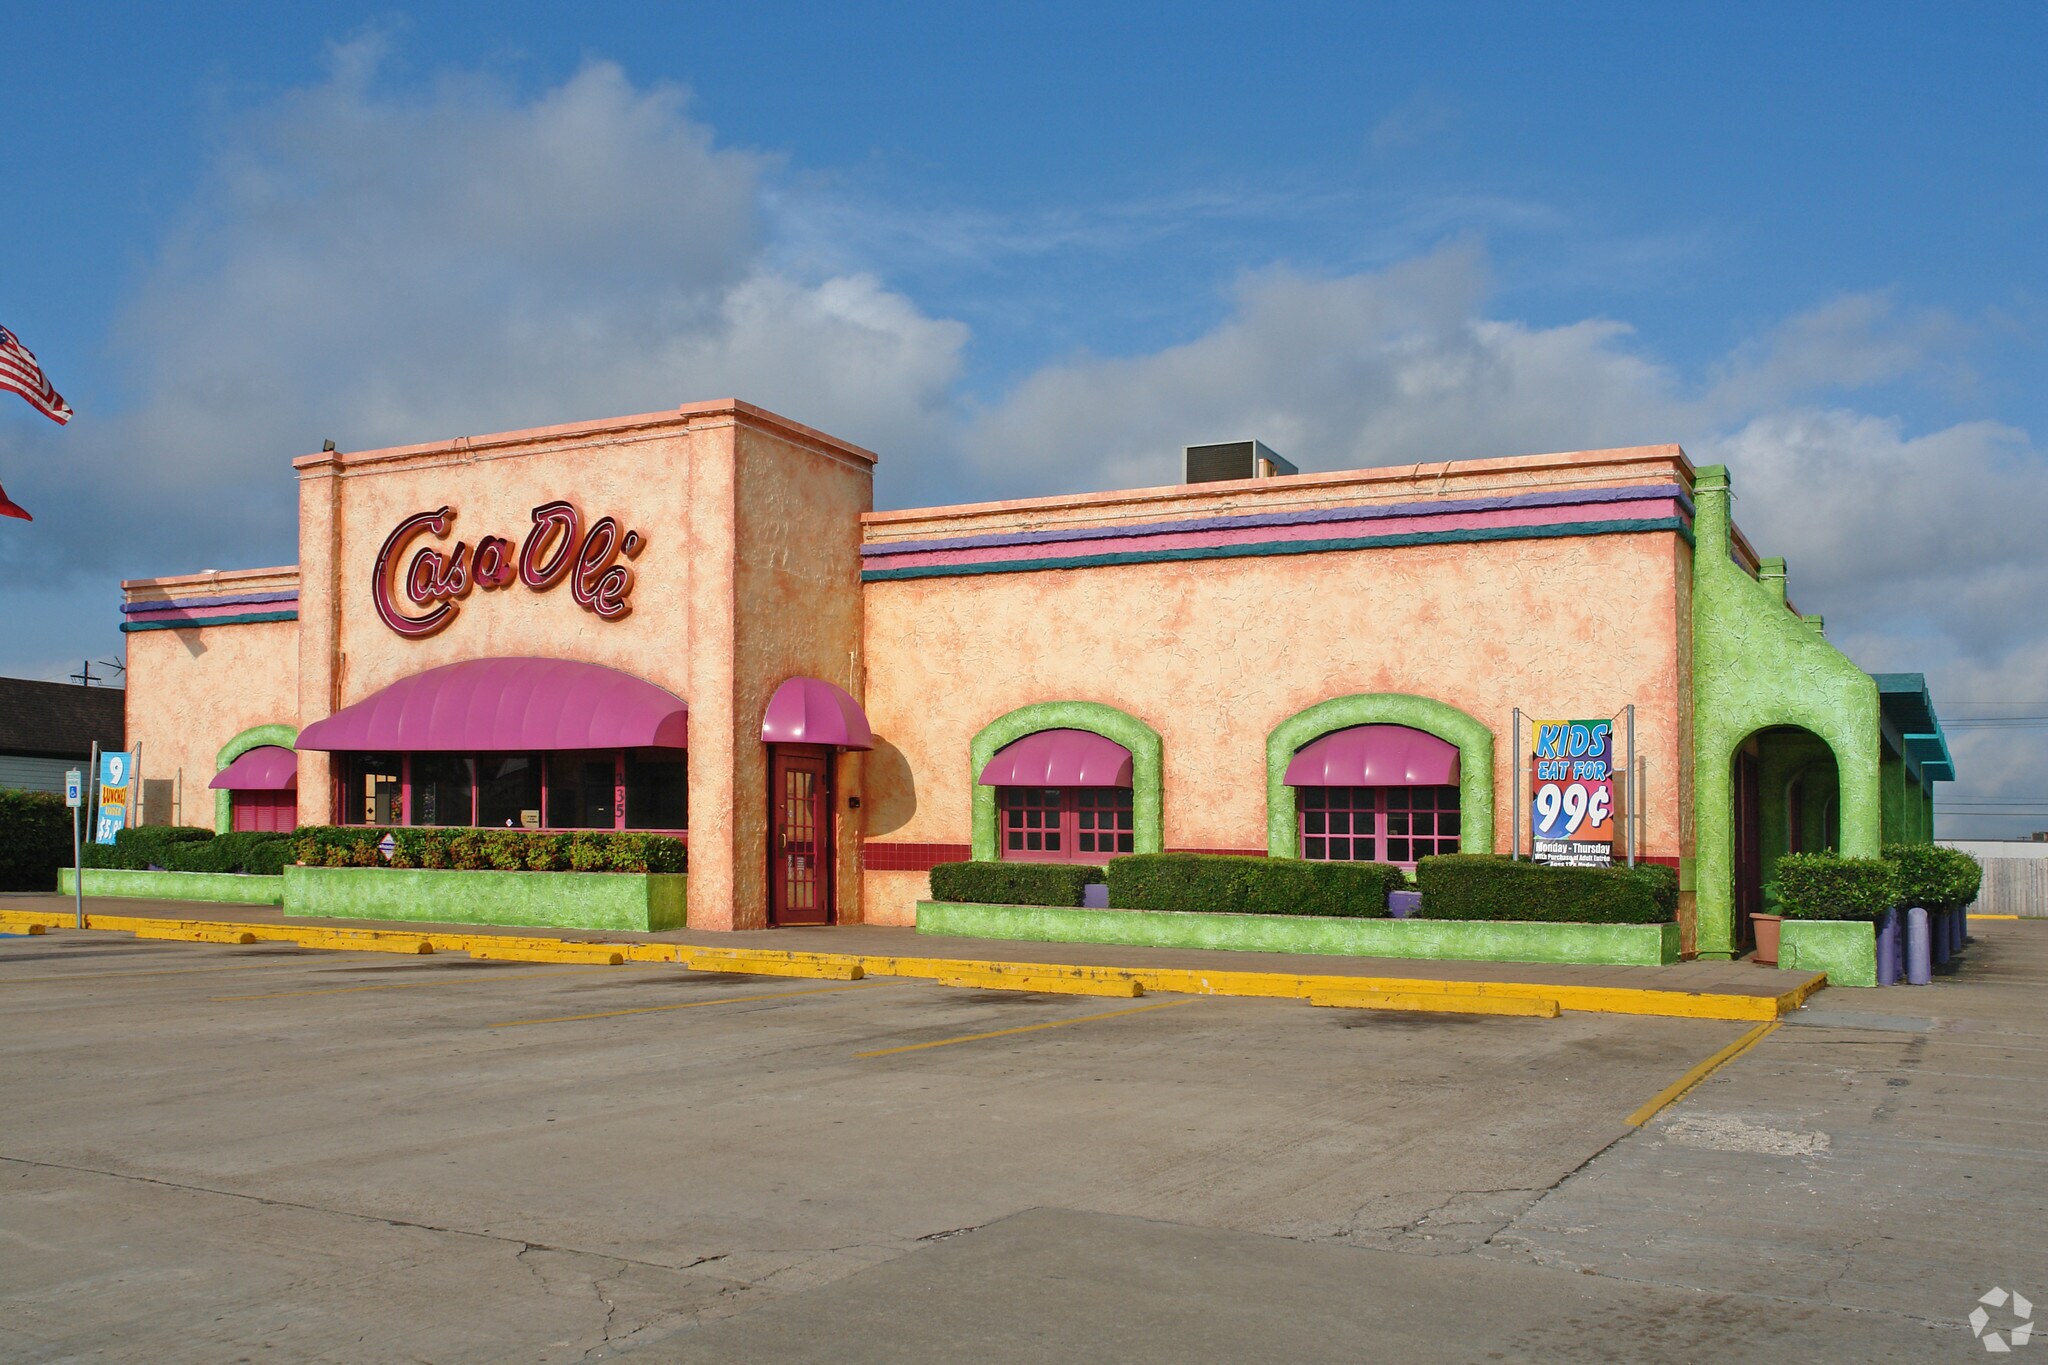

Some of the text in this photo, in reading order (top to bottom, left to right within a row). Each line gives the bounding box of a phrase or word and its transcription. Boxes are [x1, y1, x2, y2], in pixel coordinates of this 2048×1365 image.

[372, 505, 517, 639] Casa
[1536, 724, 1608, 759] KIDS
[110, 756, 124, 785] 9
[1537, 761, 1607, 781] EAT FOR
[615, 772, 625, 818] 335
[1537, 783, 1610, 833] 99¢
[1535, 841, 1568, 854] Monday
[1573, 842, 1611, 855] Thursday
[1548, 853, 1573, 861] Purchase
